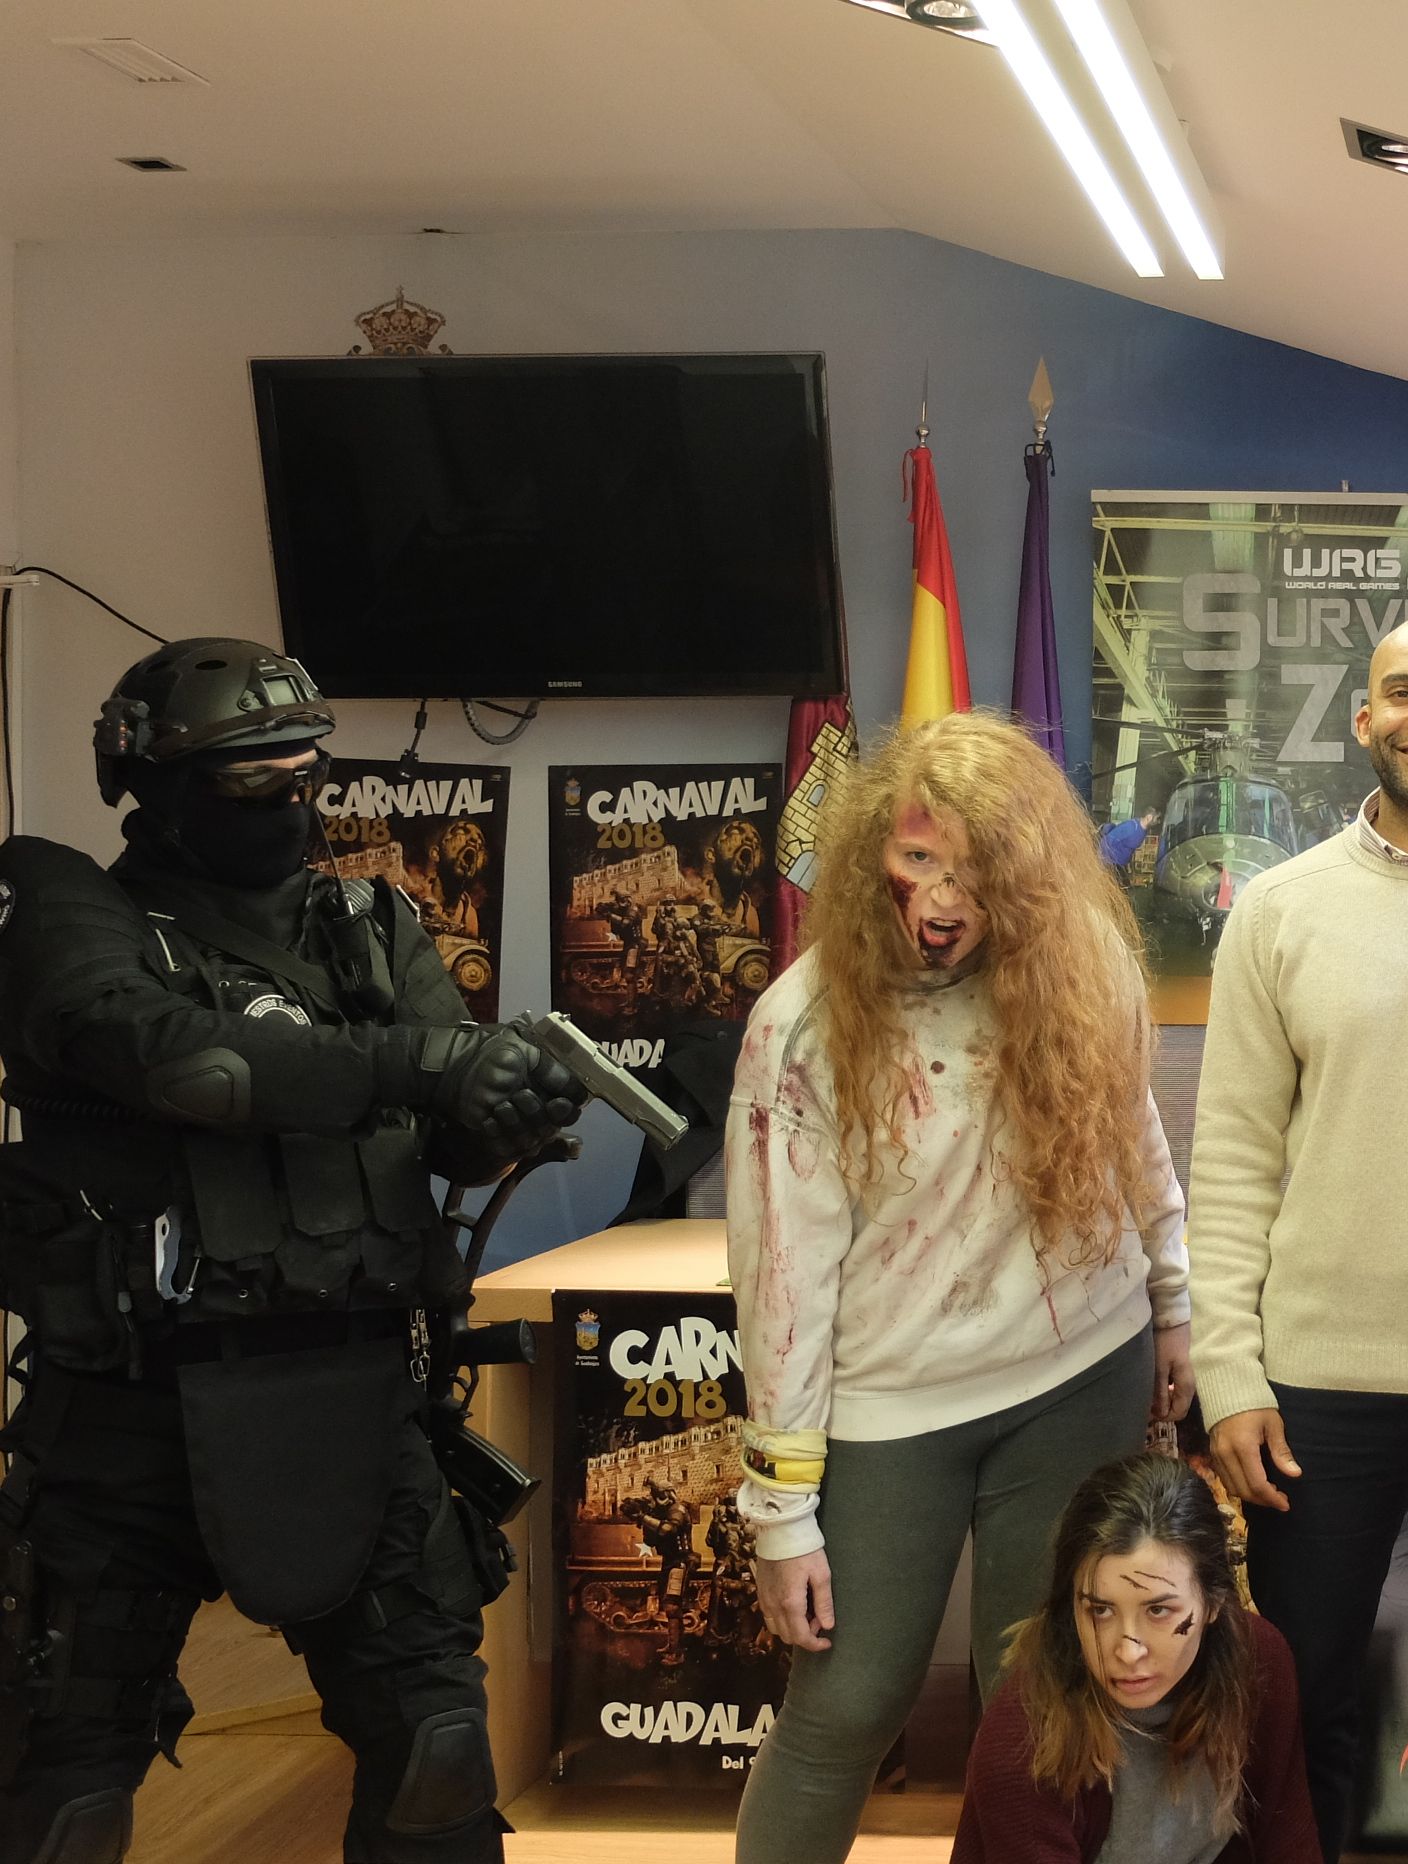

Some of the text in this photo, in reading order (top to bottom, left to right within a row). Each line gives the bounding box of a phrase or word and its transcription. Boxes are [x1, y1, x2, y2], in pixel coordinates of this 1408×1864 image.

[1283, 548, 1401, 578] WRG
[1285, 581, 1400, 591] WORLD REAL GAMES
[316, 776, 494, 819] CARNAVAL
[586, 777, 768, 827] CARNAVAL
[324, 815, 391, 844] 2018
[596, 822, 665, 849] 2018
[609, 1316, 744, 1386] CARN
[623, 1378, 727, 1419] 2018
[601, 1700, 776, 1747] GUADALA
[721, 1755, 744, 1770] Del
